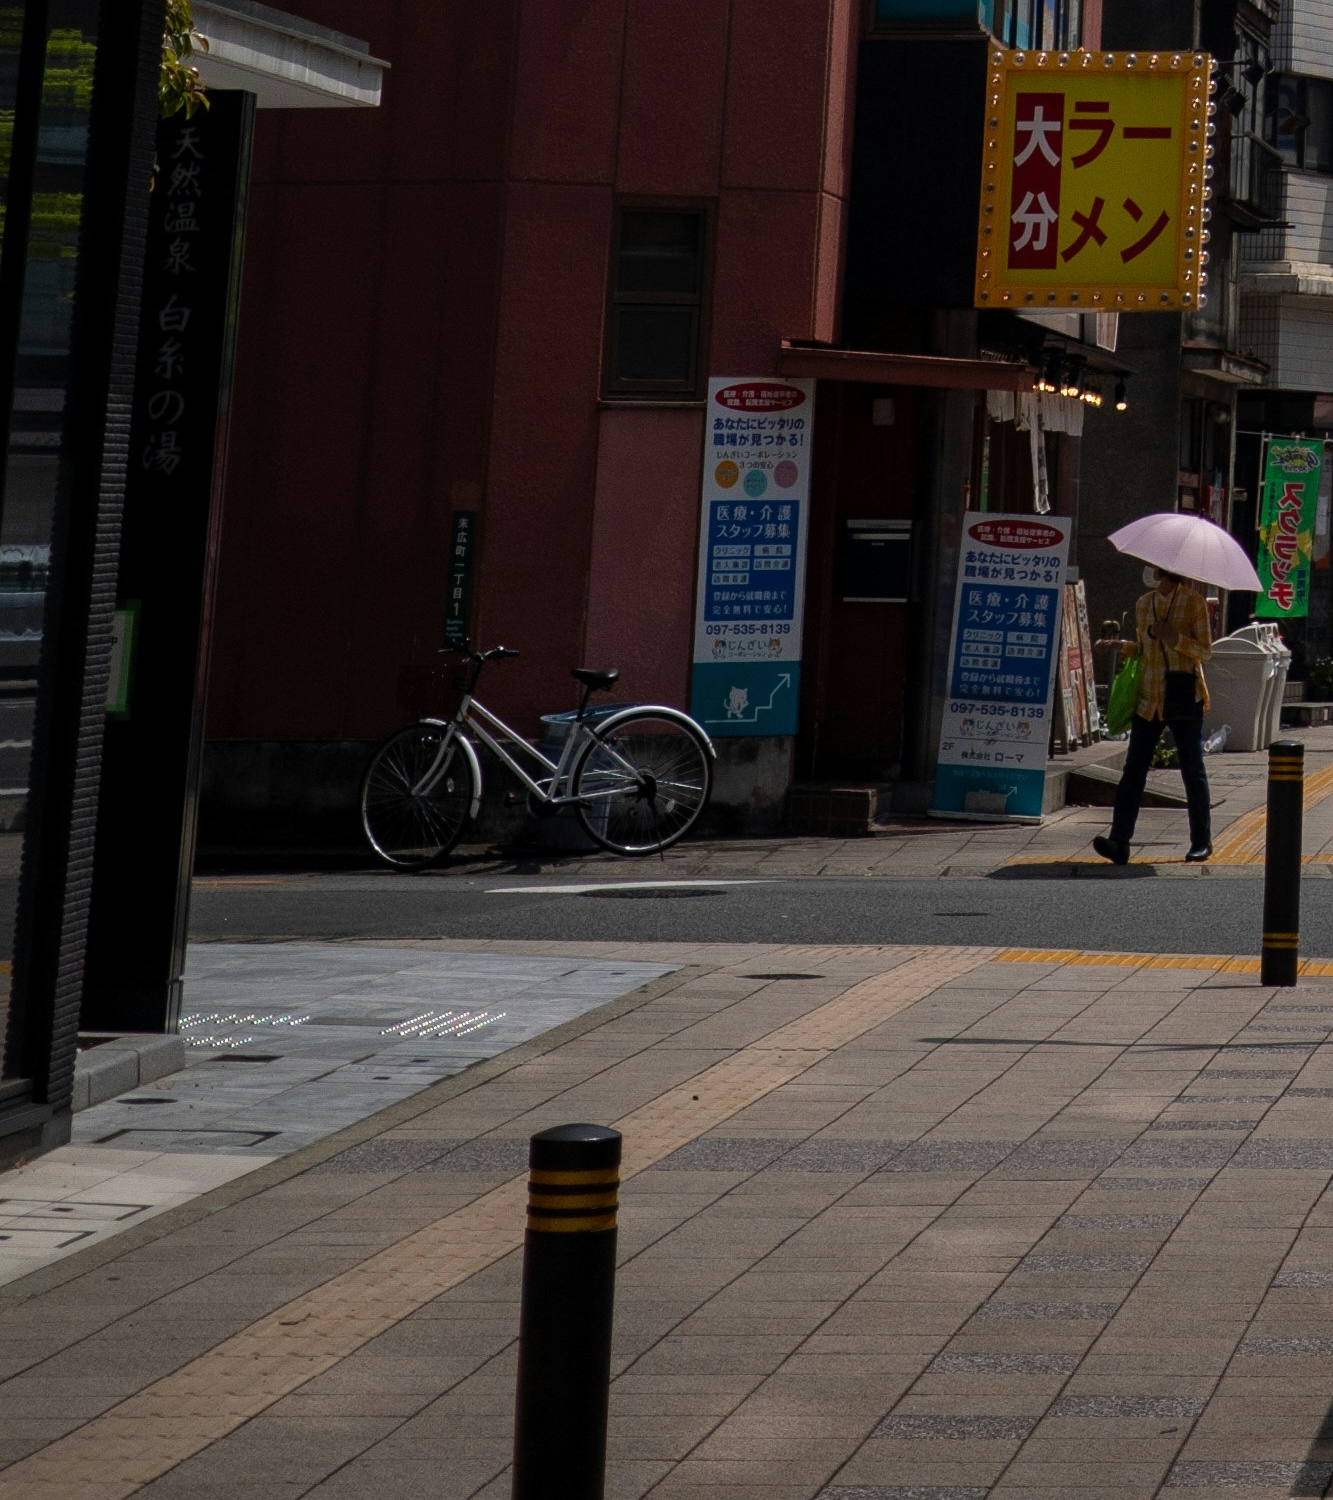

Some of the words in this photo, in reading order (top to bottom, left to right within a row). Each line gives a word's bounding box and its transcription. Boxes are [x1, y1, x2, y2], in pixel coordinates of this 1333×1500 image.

[1011, 104, 1062, 252] 大分
[163, 125, 204, 275] 天然温泉
[142, 292, 192, 475] 白糸の湯
[713, 418, 805, 431] あなたにピッタリの
[713, 433, 803, 446] 職場が見つかる!
[717, 504, 793, 521] 医療・介護
[716, 523, 792, 539] スタッフ募集
[715, 546, 750, 555] クリニック
[965, 550, 1060, 567] あなたにピッタリの
[968, 590, 1050, 611] 医療・介護
[967, 610, 1048, 627] スタッフ募集
[705, 624, 791, 636] 097-535-8139
[728, 640, 768, 652] じんざい
[950, 702, 1044, 718] 097-535-8139
[995, 751, 1025, 764] ローマ
